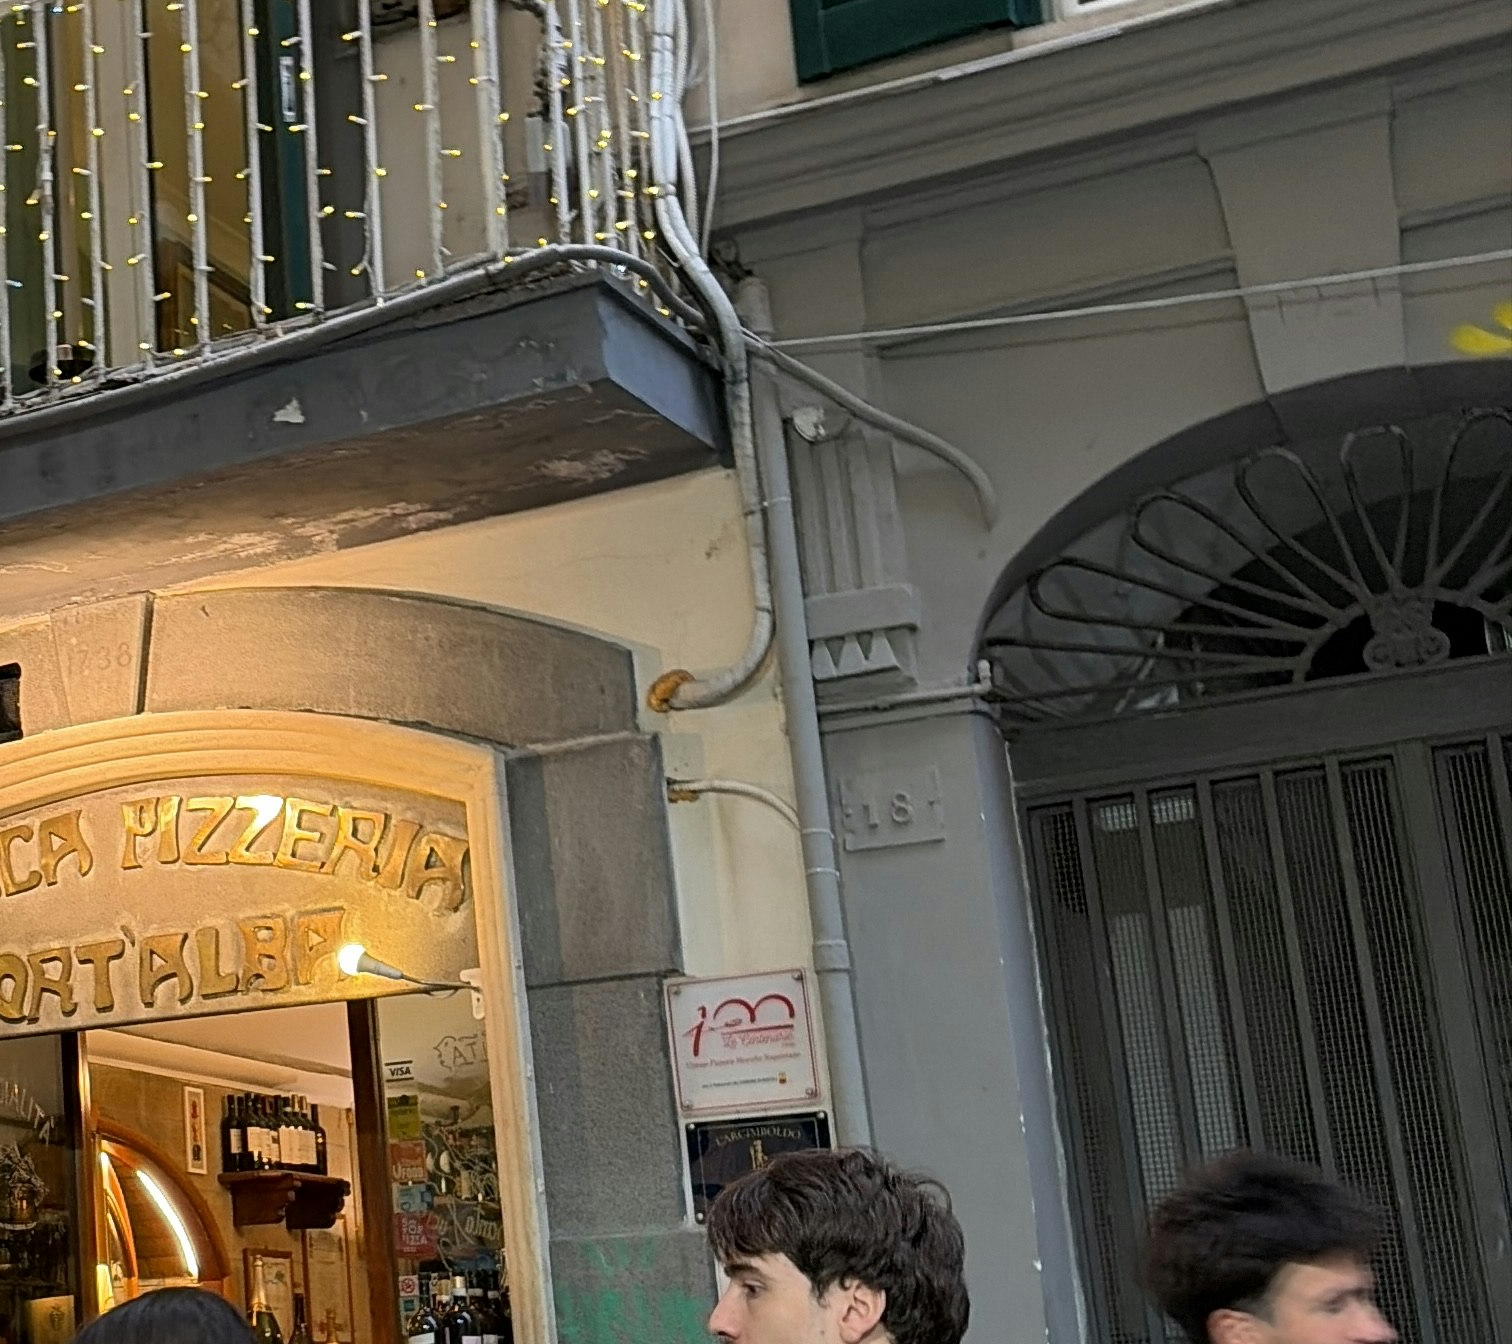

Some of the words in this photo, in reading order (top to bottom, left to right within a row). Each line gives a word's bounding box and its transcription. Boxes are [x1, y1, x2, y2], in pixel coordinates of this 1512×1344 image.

[862, 792, 913, 829] 18
[121, 795, 472, 913] PIZZERIA
[389, 1066, 412, 1077] VISA
